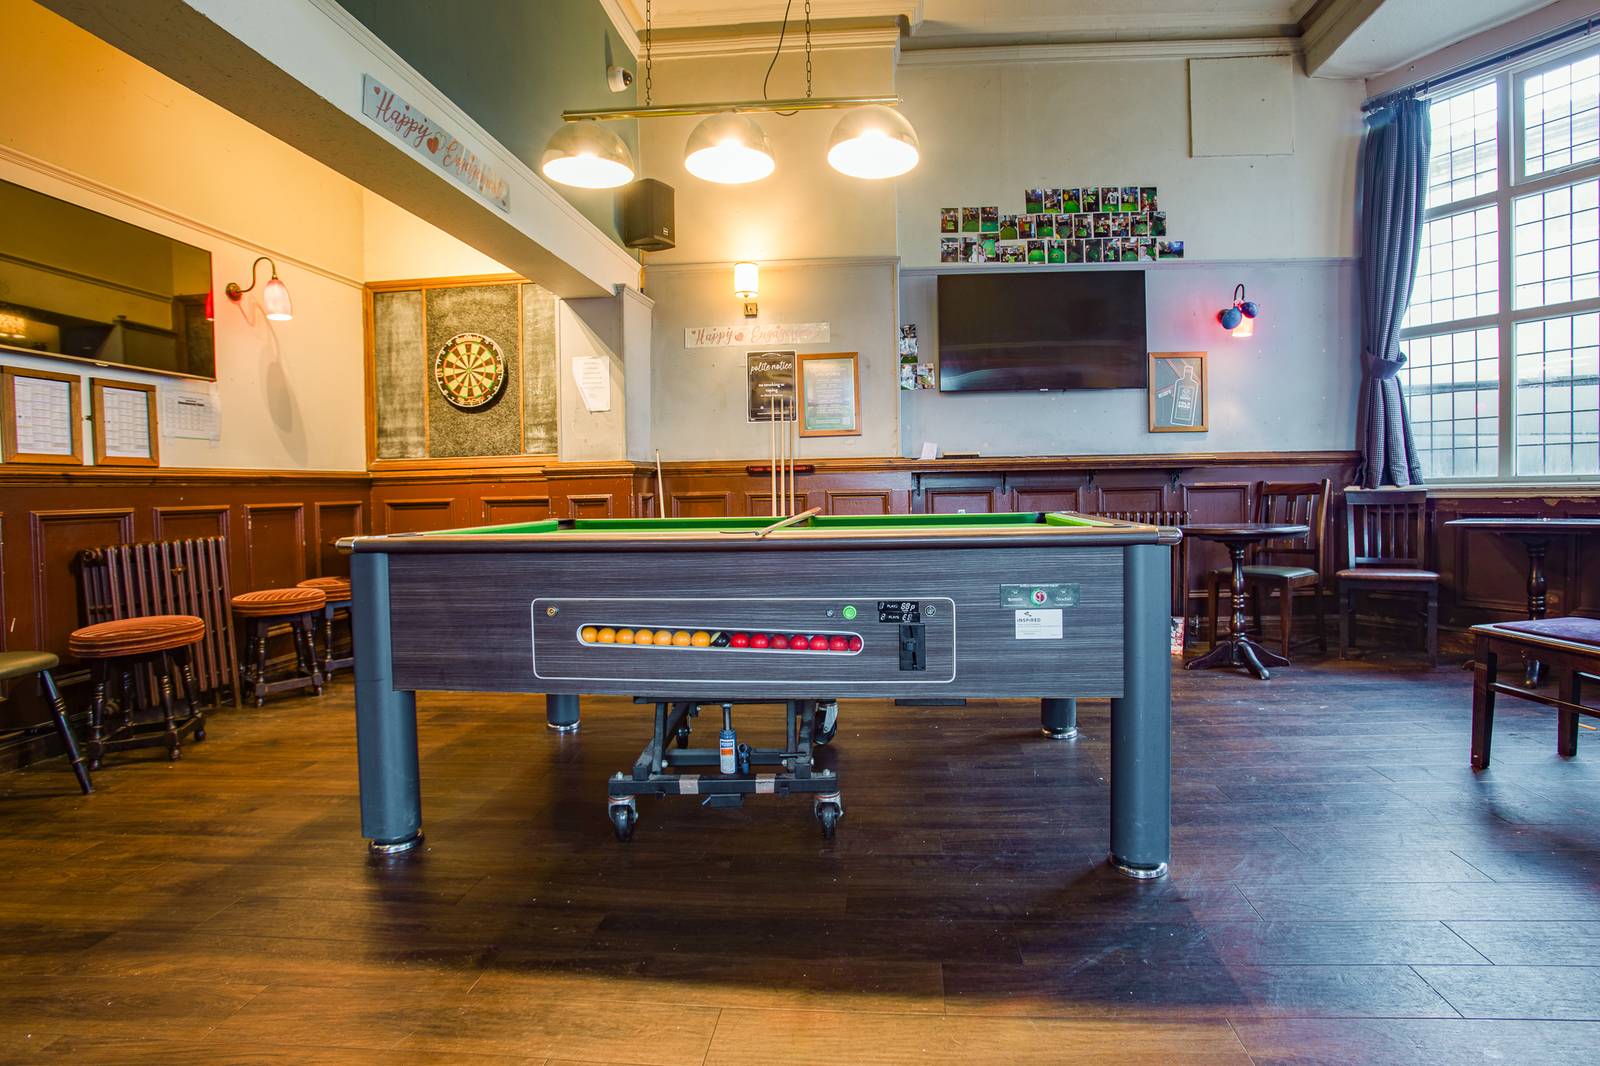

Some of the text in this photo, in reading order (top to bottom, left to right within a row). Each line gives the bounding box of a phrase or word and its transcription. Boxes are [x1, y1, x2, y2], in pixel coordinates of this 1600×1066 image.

[376, 90, 431, 148] Happy
[695, 327, 734, 345] Happy
[750, 359, 793, 375] polite notice
